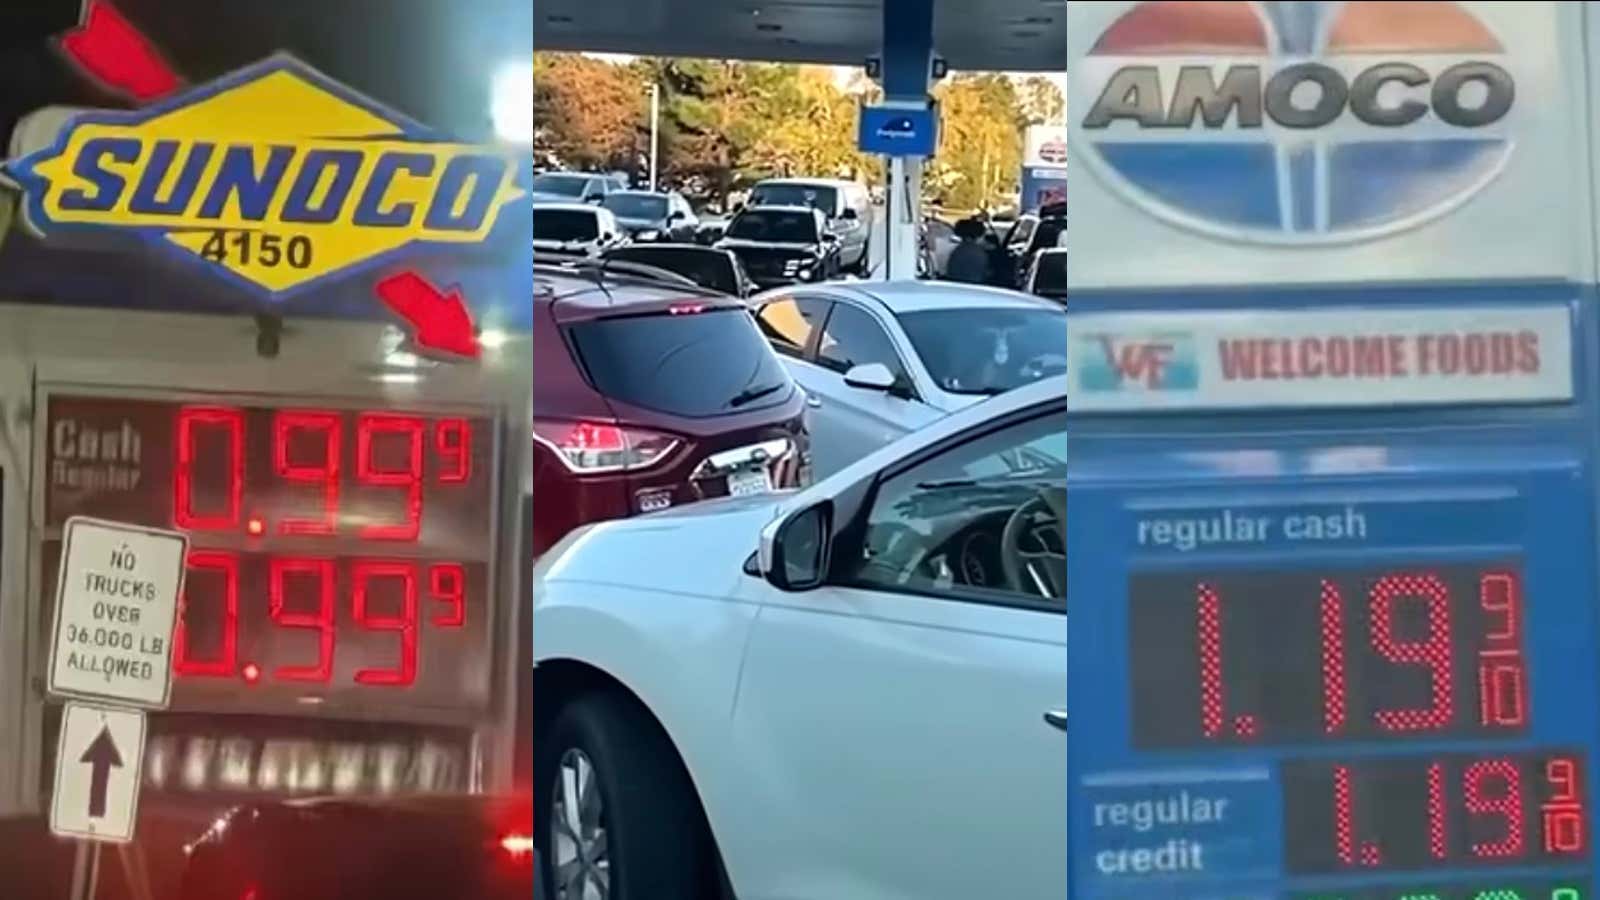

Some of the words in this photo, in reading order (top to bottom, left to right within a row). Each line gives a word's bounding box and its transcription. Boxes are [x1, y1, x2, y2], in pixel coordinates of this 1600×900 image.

[1082, 61, 1516, 130] AMOCO
[58, 137, 498, 232] SUNOCO
[202, 230, 312, 268] 4150
[1218, 335, 1409, 380] WELCOME
[1417, 330, 1541, 374] FOODS
[53, 418, 141, 463] Cash
[1137, 510, 1269, 549] regular
[1283, 508, 1367, 540] cash
[110, 549, 136, 571] NO
[86, 573, 156, 601] TRUCKS
[93, 601, 140, 624] OVER
[140, 636, 163, 655] LB
[67, 652, 152, 681] ALLOWED
[1094, 791, 1228, 831] regular
[1096, 842, 1203, 874] credit
